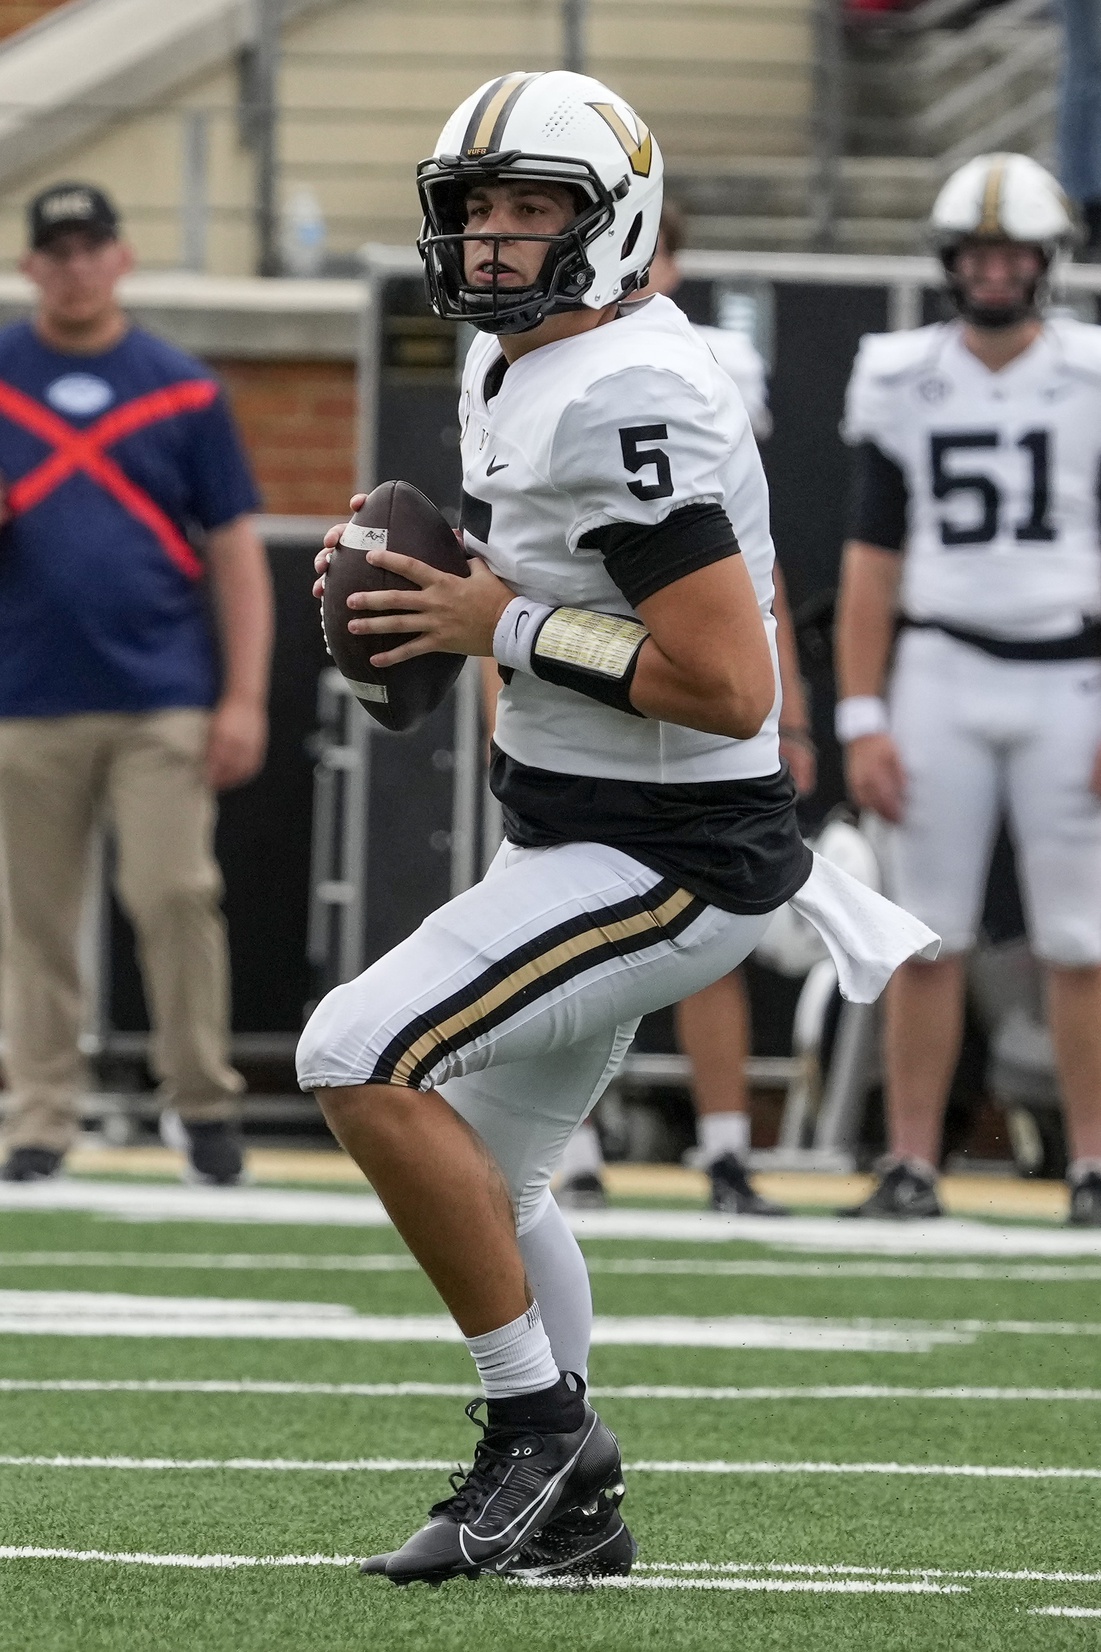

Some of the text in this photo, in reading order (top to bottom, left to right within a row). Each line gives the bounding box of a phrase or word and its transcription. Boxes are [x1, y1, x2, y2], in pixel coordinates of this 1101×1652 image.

[584, 102, 652, 178] V
[618, 423, 675, 502] 5
[929, 430, 1058, 545] 51
